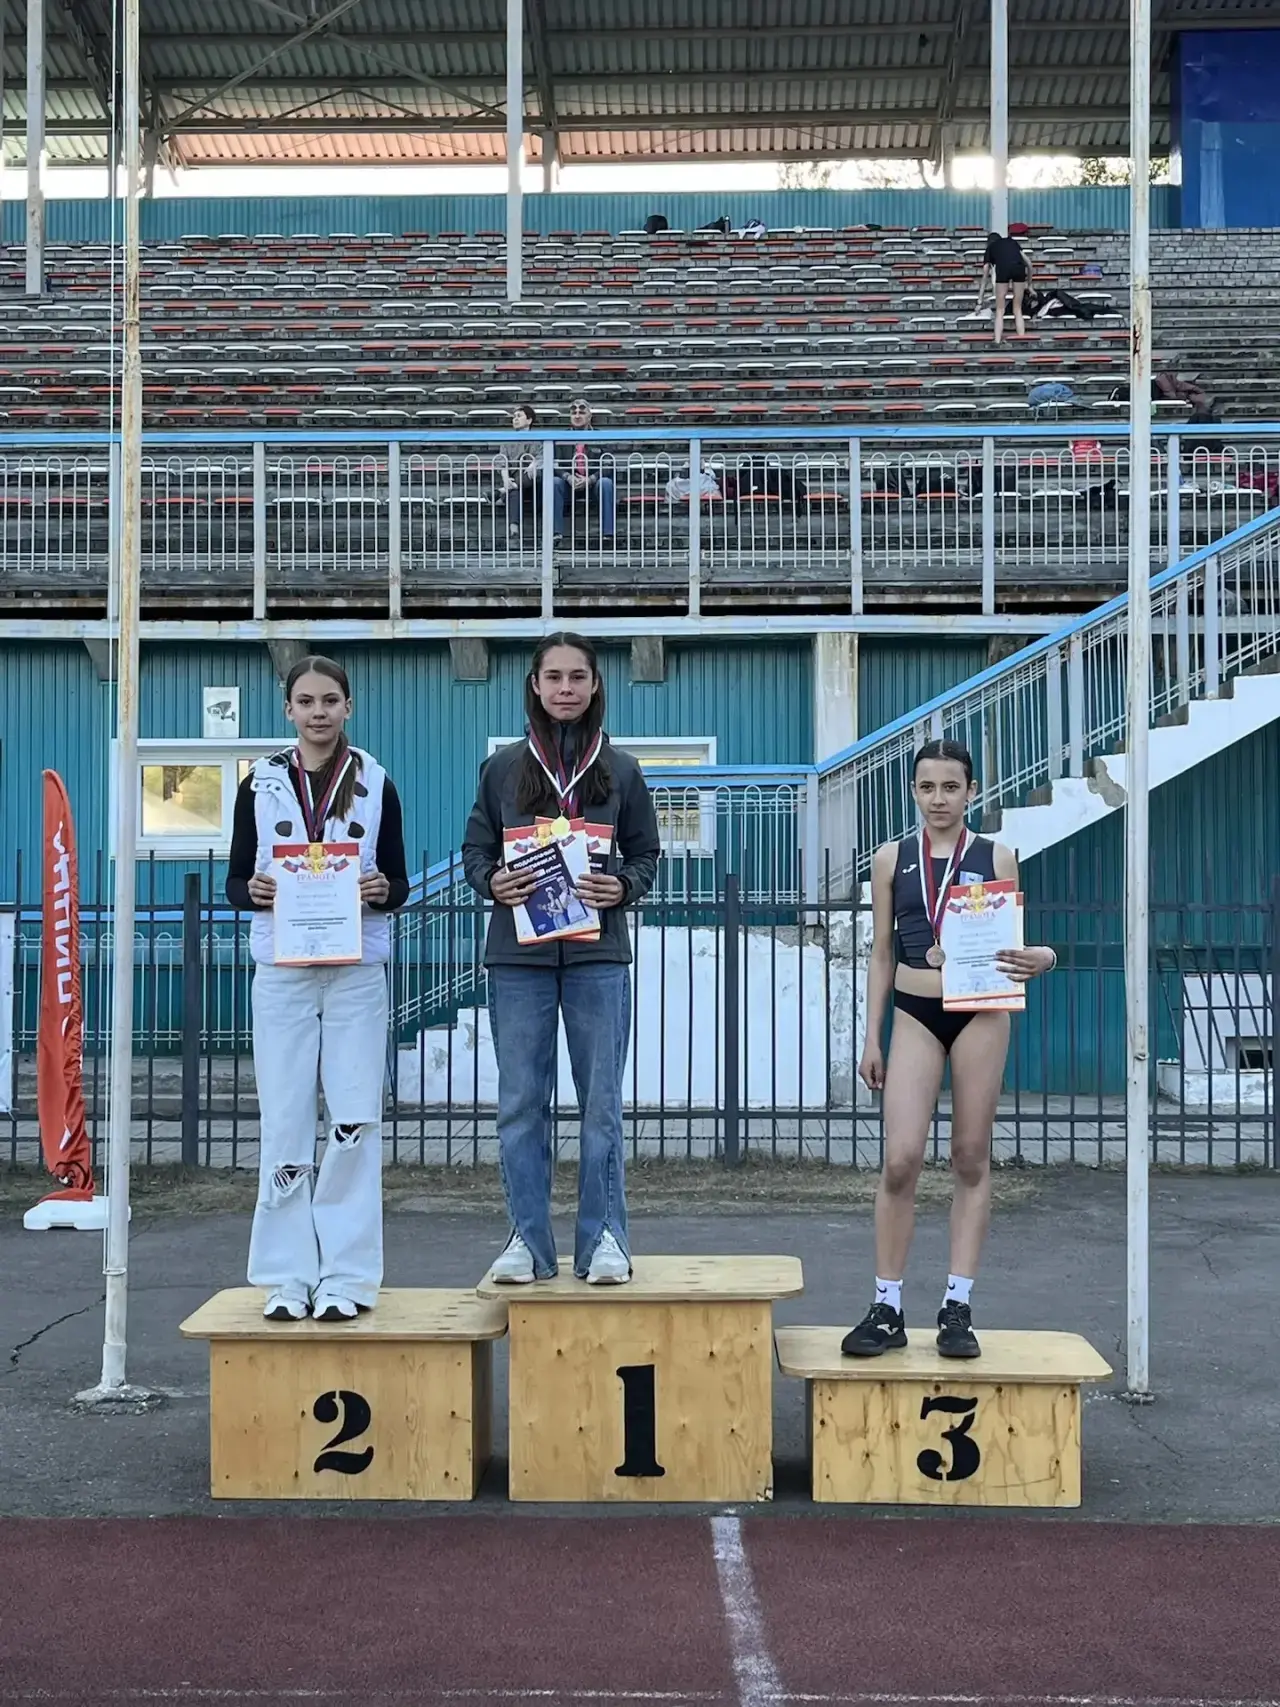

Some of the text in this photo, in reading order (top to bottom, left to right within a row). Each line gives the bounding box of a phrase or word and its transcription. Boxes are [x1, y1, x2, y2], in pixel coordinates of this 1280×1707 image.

[296, 873, 336, 881] ГРАМОТА
[313, 1390, 374, 1475] 2
[614, 1364, 665, 1476] 1
[917, 1396, 980, 1481] 3
